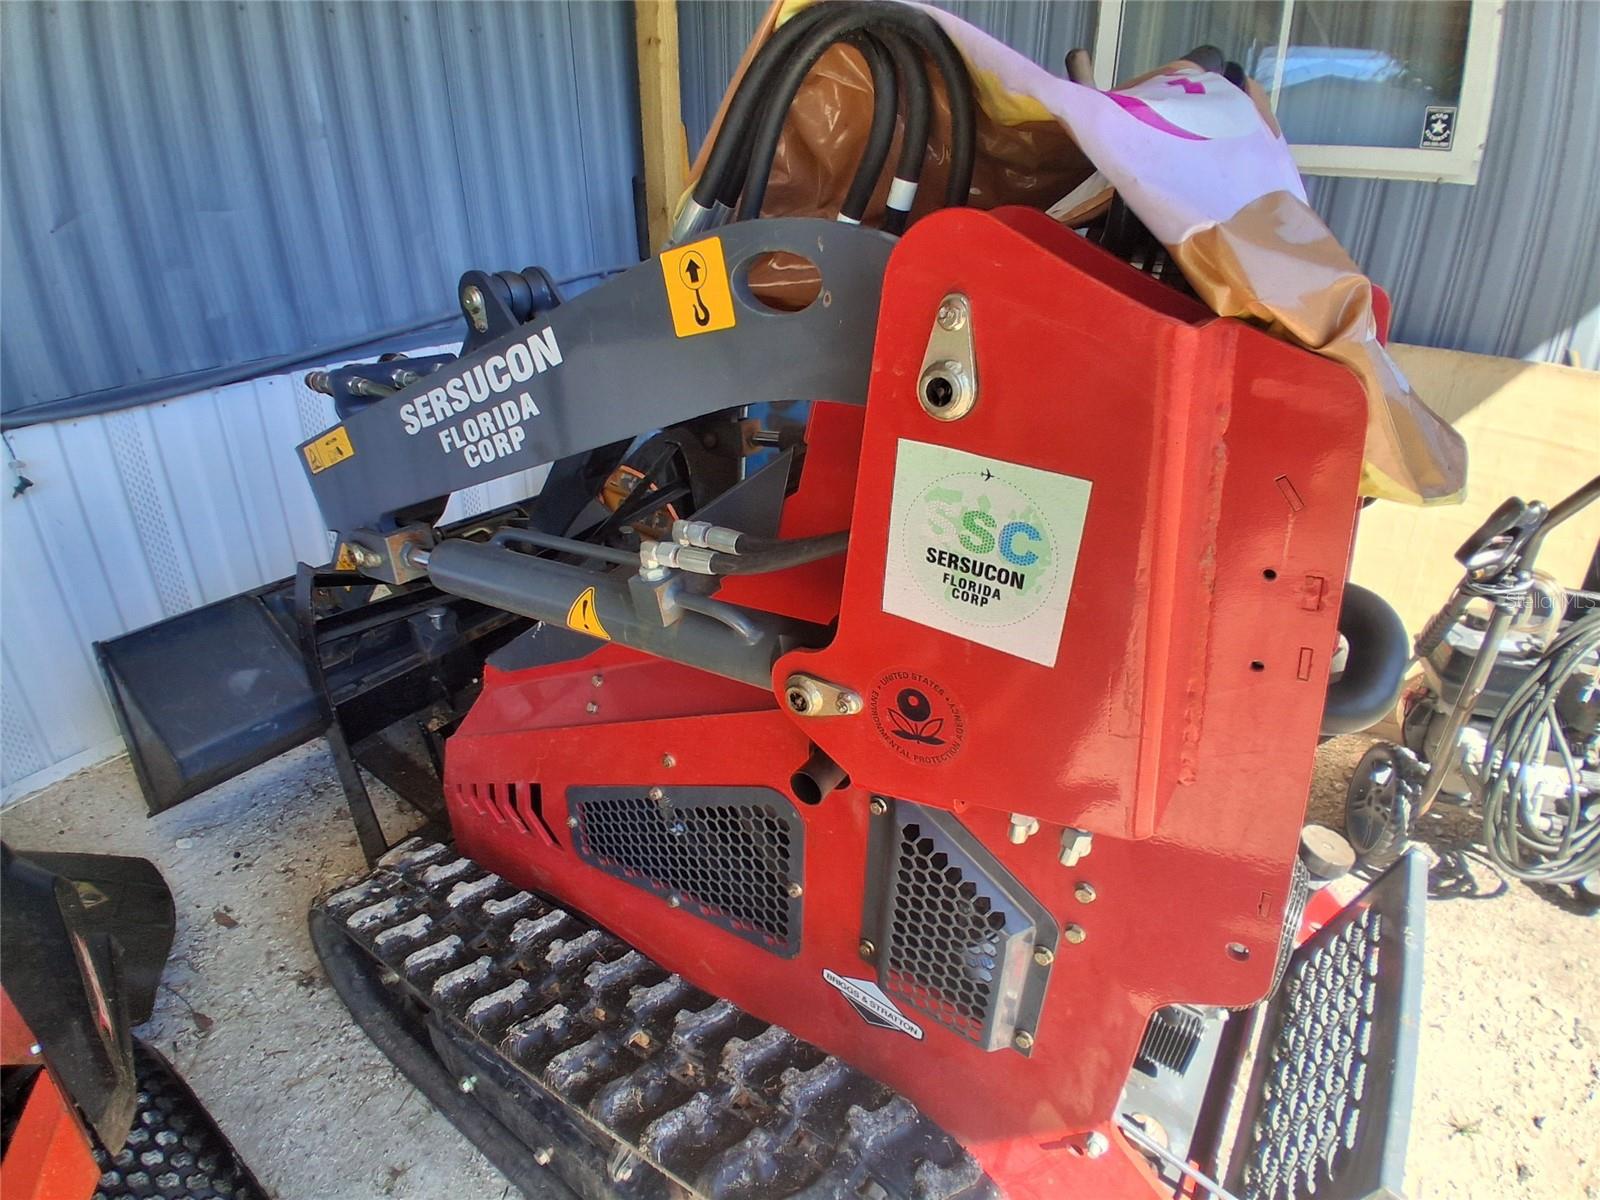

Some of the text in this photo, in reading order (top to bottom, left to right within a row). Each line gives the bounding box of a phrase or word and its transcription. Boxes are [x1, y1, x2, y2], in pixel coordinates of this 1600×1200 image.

[400, 326, 563, 435] SERSUCON
[438, 392, 540, 453] FLORIDA
[463, 426, 526, 468] CORP
[926, 547, 1025, 590] SERSUCON
[942, 572, 1001, 601] FLORIDA
[951, 587, 989, 608] CORP
[880, 671, 944, 696] UNITED STATES
[826, 972, 918, 1035] BRIGGS & STRATTON
